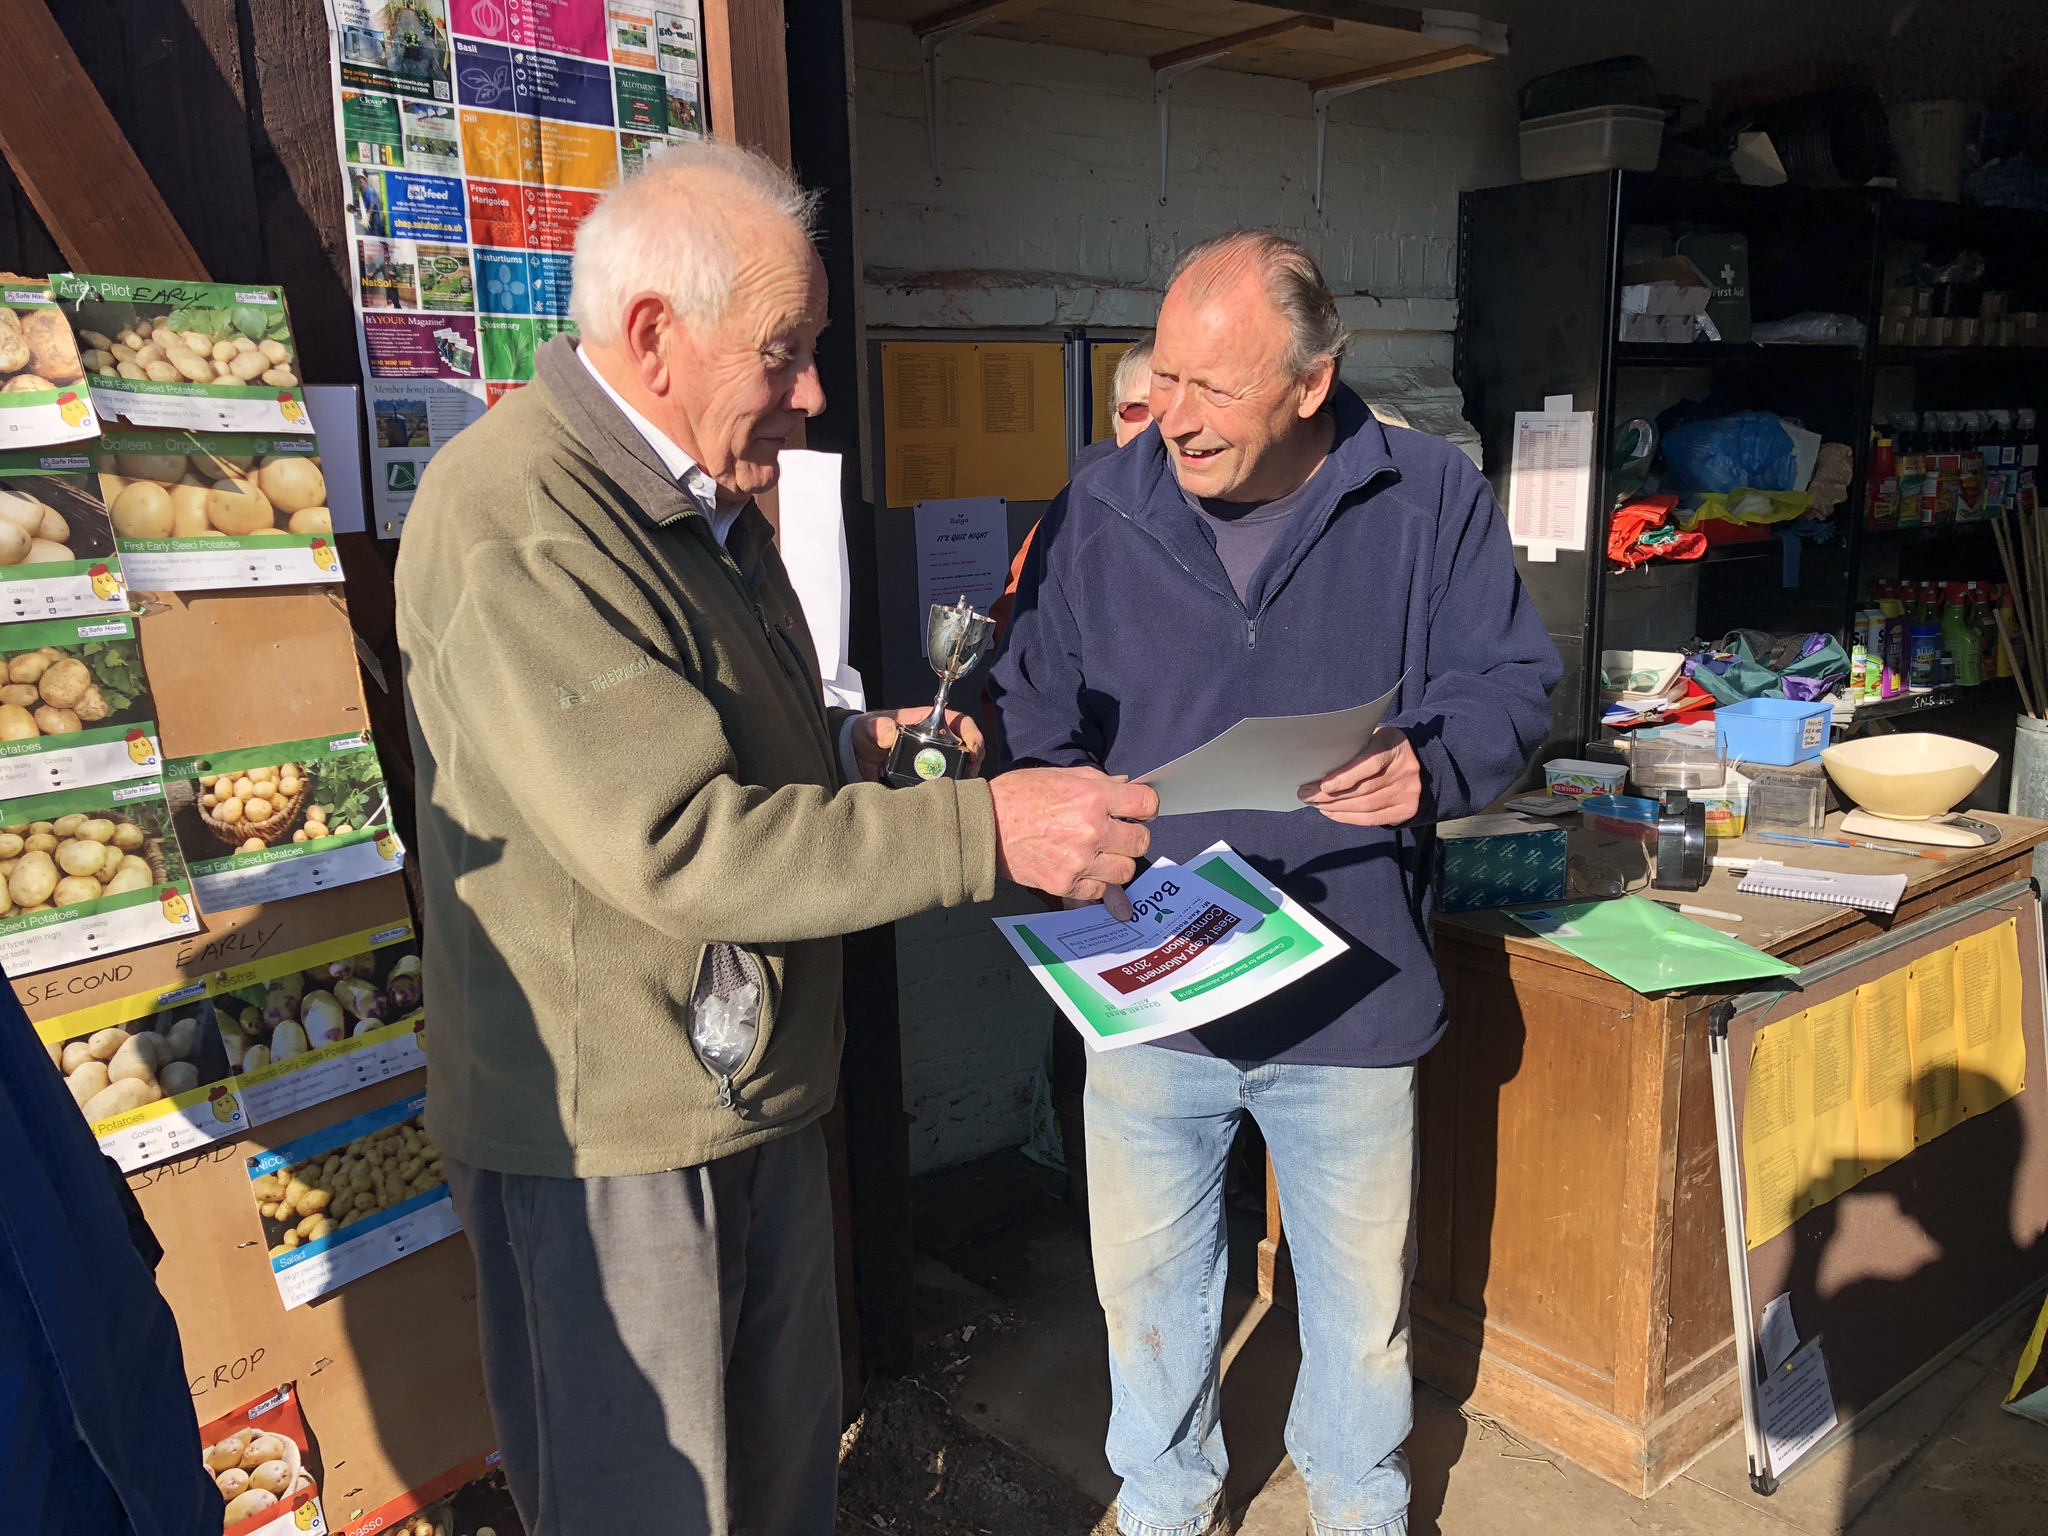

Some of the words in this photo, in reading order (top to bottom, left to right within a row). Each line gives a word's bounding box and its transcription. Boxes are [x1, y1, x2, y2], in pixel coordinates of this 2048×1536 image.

[457, 42, 478, 53] Basil
[622, 80, 656, 92] ALLOTMENT
[359, 96, 382, 108] Clover
[463, 114, 478, 123] Dill
[470, 184, 497, 195] French
[471, 195, 509, 207] Marigolds
[394, 219, 463, 232] shop.solufeed.co.uk
[477, 253, 523, 264] Nasturtiums
[362, 278, 392, 288] NatSol
[101, 283, 131, 296] Pilot
[1733, 287, 1744, 297] Aid
[15, 292, 30, 300] Safe
[132, 287, 208, 313] EARLY
[366, 316, 376, 324] It's
[376, 316, 406, 324] YOUR
[408, 317, 445, 328] Magazine!
[483, 321, 519, 331] Rosemary
[93, 377, 114, 388] First
[115, 380, 138, 393] Early
[139, 384, 165, 394] Seed
[166, 385, 208, 396] Potatoes
[374, 385, 404, 394] Member
[406, 384, 434, 396] benefits
[489, 387, 511, 395] Thym
[101, 438, 151, 451] Colleen
[165, 438, 216, 453] Organic
[951, 533, 967, 542] QUIZ
[968, 531, 989, 540] NIGHT
[124, 542, 144, 551] First
[146, 542, 169, 552] Early
[172, 541, 197, 550] Seed
[200, 540, 241, 548] Potatoes
[7, 586, 34, 594] Cooking
[104, 624, 126, 632] Haven
[0, 742, 41, 755] otatoes
[45, 755, 72, 765] Cooking
[14, 762, 31, 771] waxy
[168, 763, 198, 777] Swift
[139, 785, 159, 793] Haven
[1554, 786, 1582, 794] BERTOLLI
[214, 860, 236, 872] Early
[238, 855, 262, 867] Seed
[263, 846, 304, 862] Potatoes
[1130, 880, 1180, 923] Balga
[1200, 900, 1211, 909] Mr.
[1188, 909, 1200, 920] Ken
[0, 919, 26, 934] Seed
[30, 909, 78, 927] Potatoes
[81, 920, 108, 931] Cooking
[1213, 914, 1237, 935] Best
[377, 931, 390, 940] Safe
[1162, 907, 1223, 956] Competition
[1163, 920, 1189, 940] Robbins
[7, 939, 24, 949] type
[26, 935, 43, 945] with
[44, 931, 61, 942] high
[1088, 940, 1107, 948] Voucher
[1185, 934, 1213, 955] Kept
[12, 948, 30, 958] taste
[1256, 942, 1285, 960] Certificate
[12, 960, 32, 969] finish
[22, 965, 133, 1006] SECOND
[176, 923, 283, 969] EARLY
[1122, 958, 1152, 976] 2018
[1136, 952, 1188, 983] Allotment
[1235, 963, 1248, 973] Best
[214, 970, 256, 989] Kestrel
[1220, 970, 1235, 980] Kept
[1193, 978, 1221, 992] Allotment
[167, 991, 182, 999] Safe
[1178, 989, 1194, 998] 2018
[1129, 1001, 1161, 1014] Overall
[1104, 1010, 1127, 1018] Best
[242, 1069, 277, 1086] Second
[278, 1059, 298, 1074] Early
[301, 1053, 324, 1066] Seed
[325, 1040, 362, 1058] Potatoes
[351, 1052, 377, 1064] Cooking
[98, 1113, 145, 1134] Potatoes
[132, 1125, 163, 1139] Cooking
[132, 1142, 237, 1191] SALAD
[256, 1151, 294, 1172] Nicola
[279, 1250, 306, 1268] Salad
[284, 1272, 299, 1282] High
[287, 1282, 306, 1293] bright
[307, 1273, 326, 1285] yellow
[291, 1291, 306, 1302] Easy
[190, 1348, 265, 1396] CROP
[257, 1401, 270, 1412] Safe
[348, 1516, 383, 1536] casso
